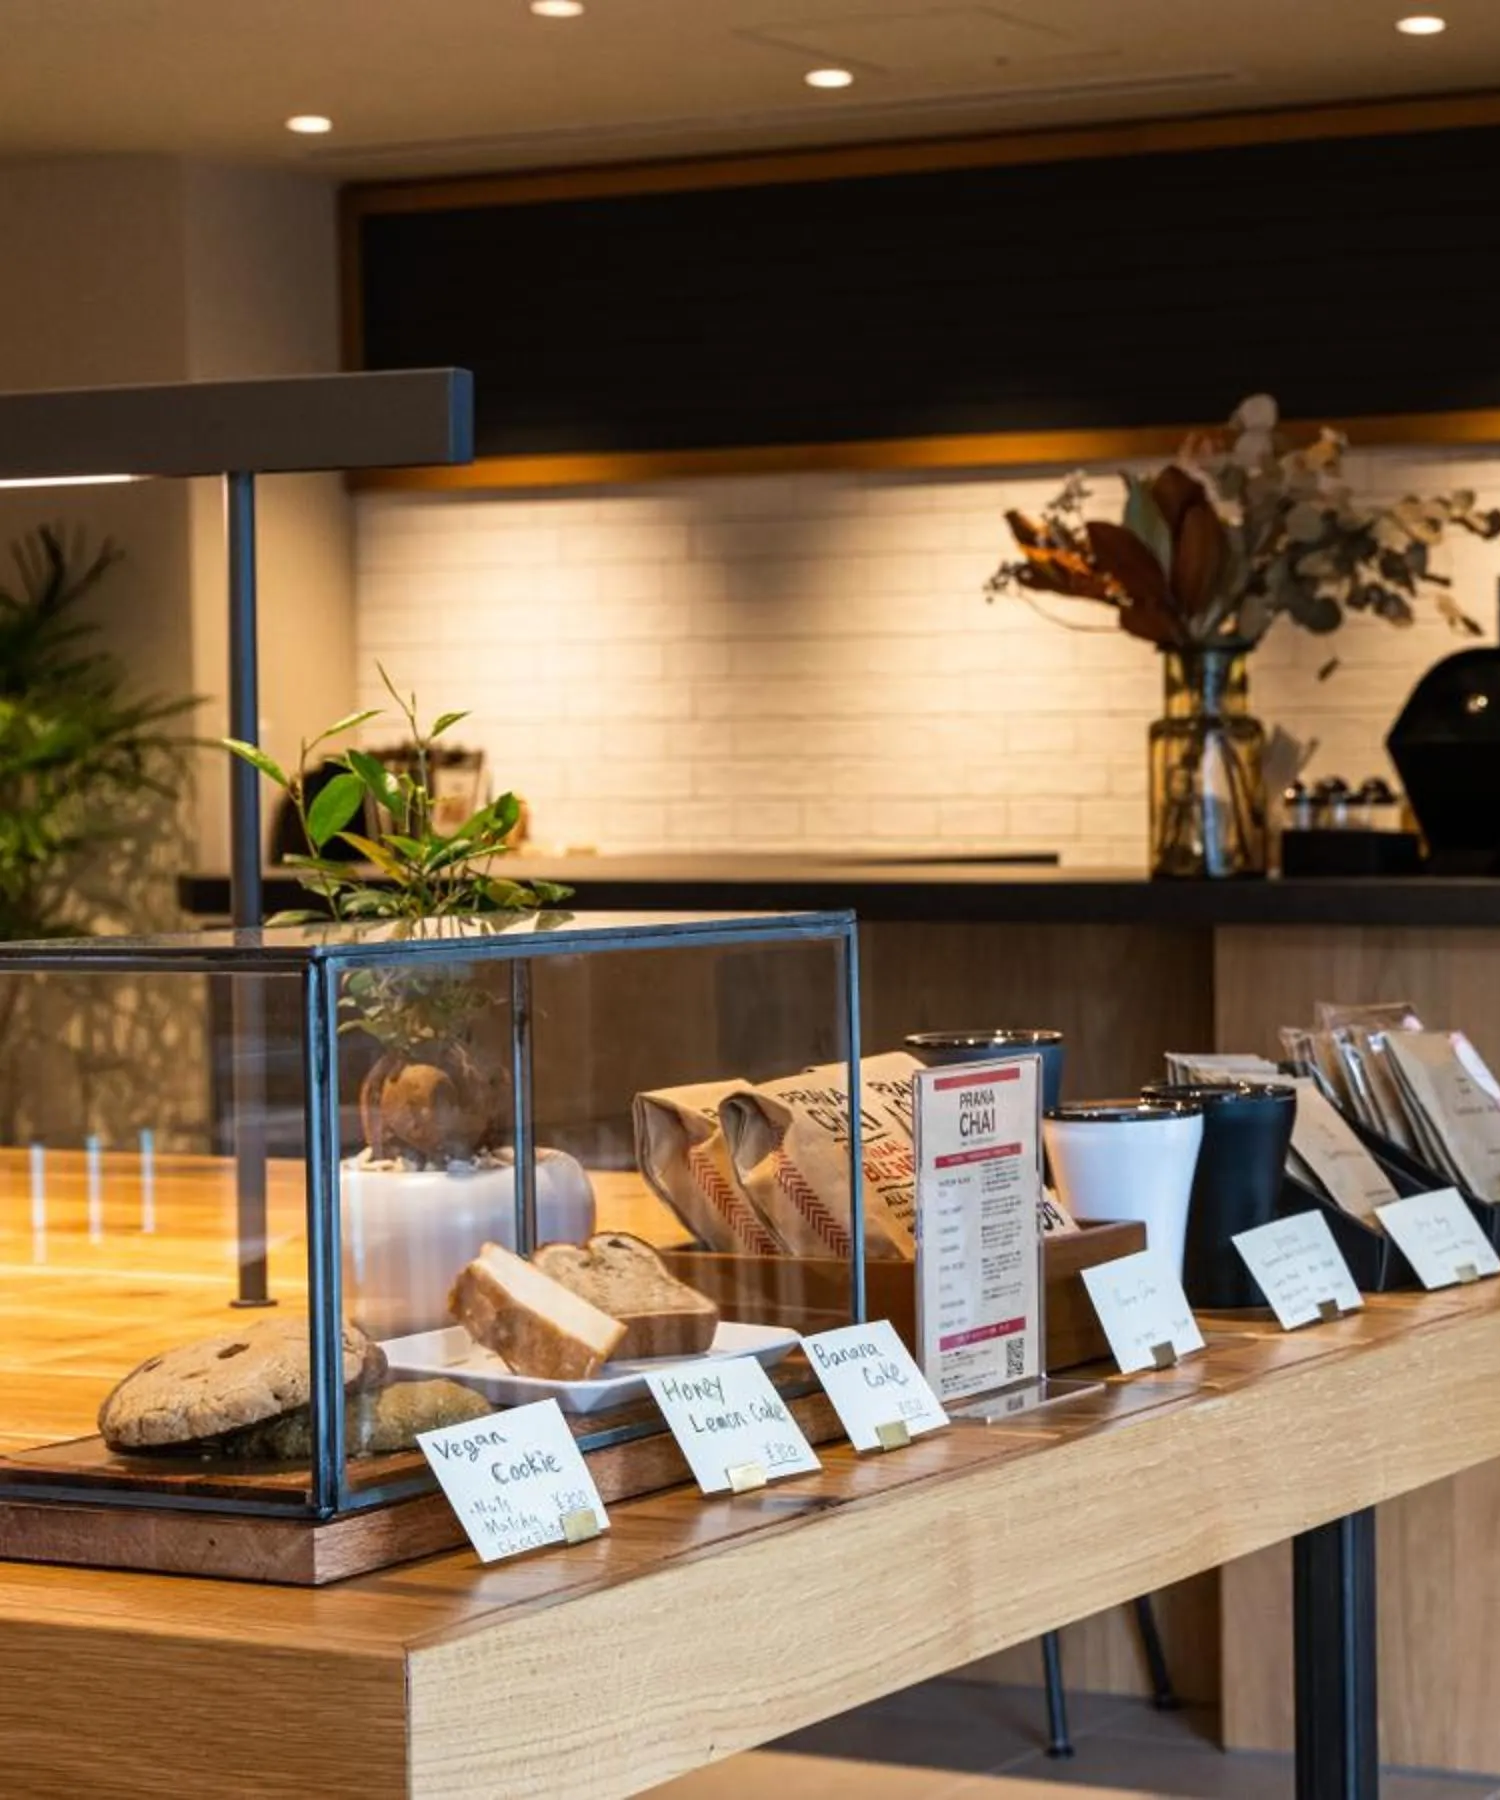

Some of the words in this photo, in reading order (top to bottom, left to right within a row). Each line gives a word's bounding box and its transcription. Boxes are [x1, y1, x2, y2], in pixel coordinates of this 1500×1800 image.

[959, 1089, 996, 1109] PRANA
[959, 1108, 996, 1137] CHAI
[812, 1343, 885, 1369] Banana
[661, 1376, 726, 1406] Honey
[688, 1411, 747, 1433] Lemon
[432, 1431, 508, 1463] Vegan
[491, 1450, 562, 1485] Cookie
